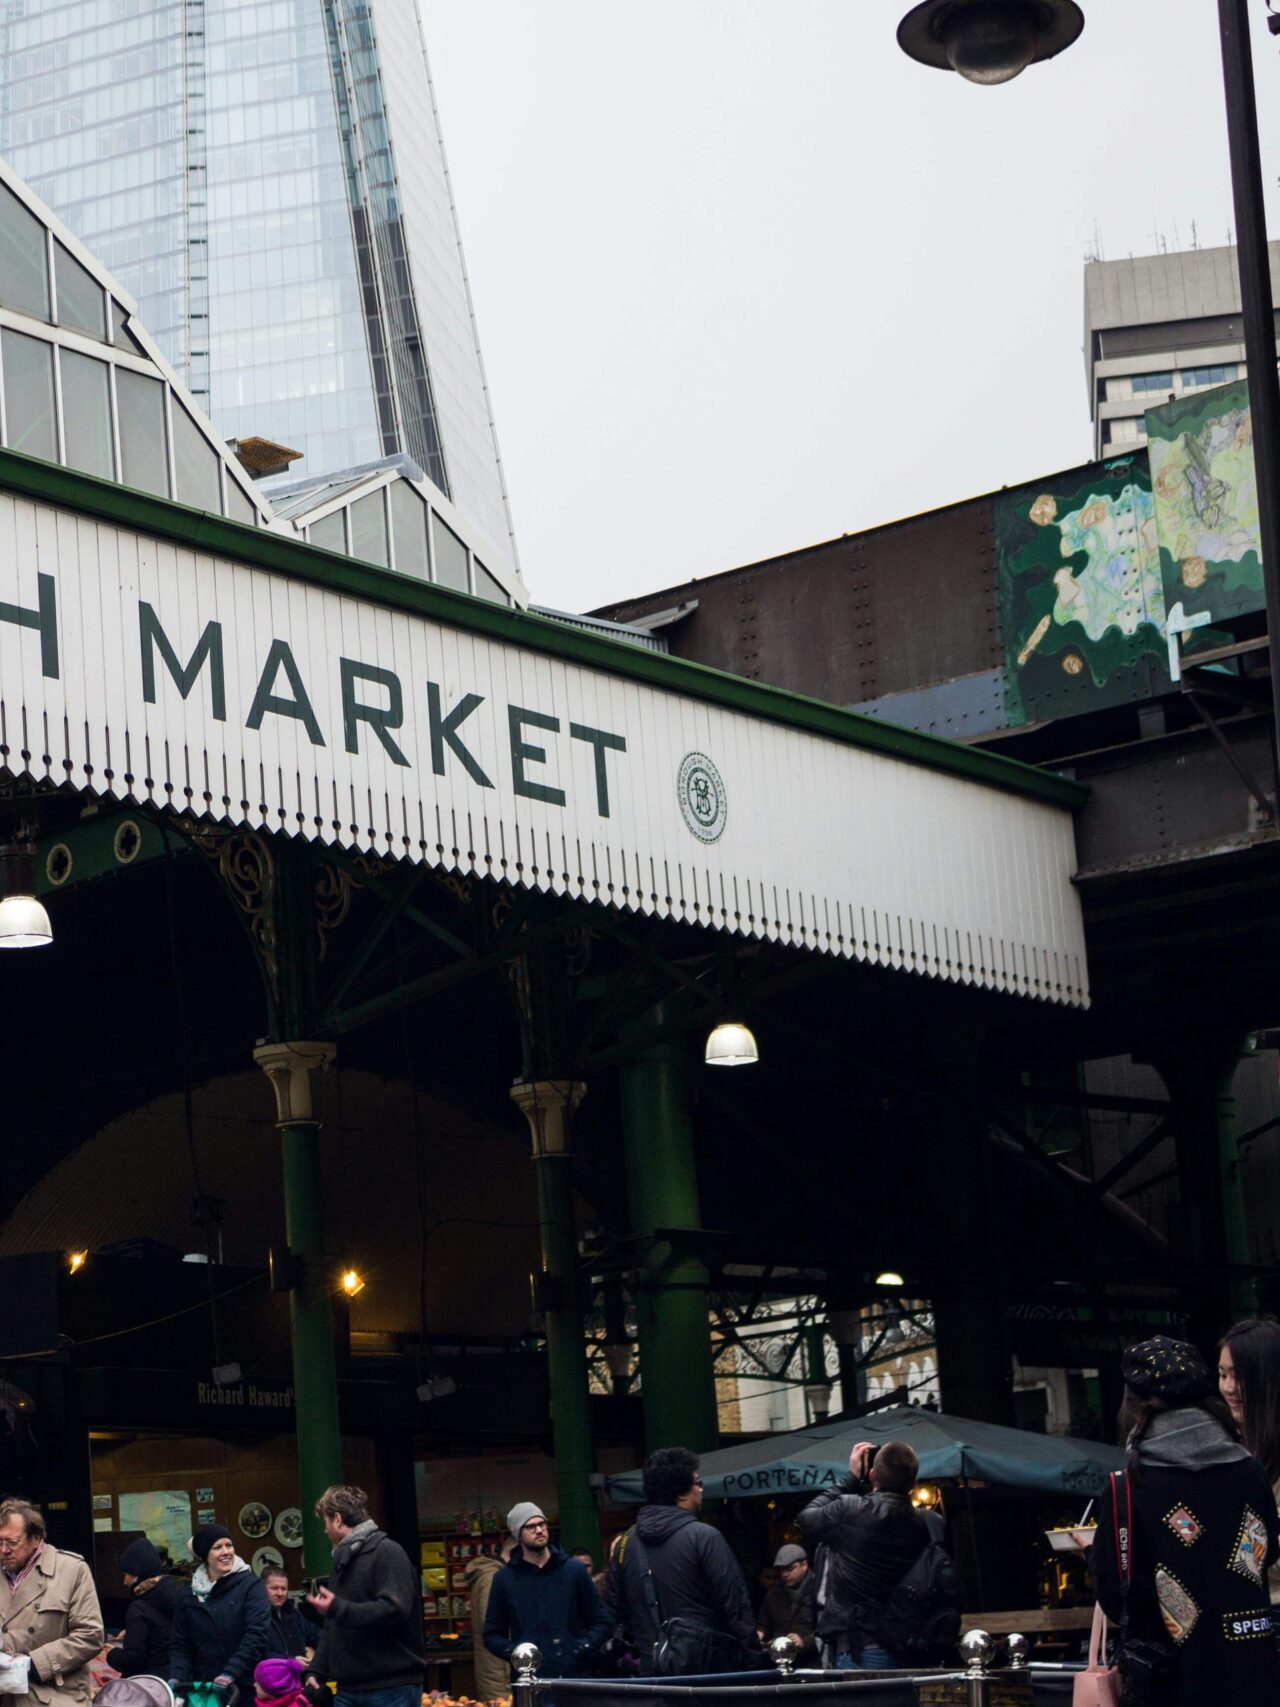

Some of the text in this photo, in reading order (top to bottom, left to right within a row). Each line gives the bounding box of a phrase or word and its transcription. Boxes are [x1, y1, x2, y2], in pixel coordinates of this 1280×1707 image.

[138, 600, 626, 819] MARKET
[197, 1381, 297, 1408] Richard Haward'
[722, 1465, 836, 1491] PORTEÑA
[1119, 1527, 1128, 1550] EOS
